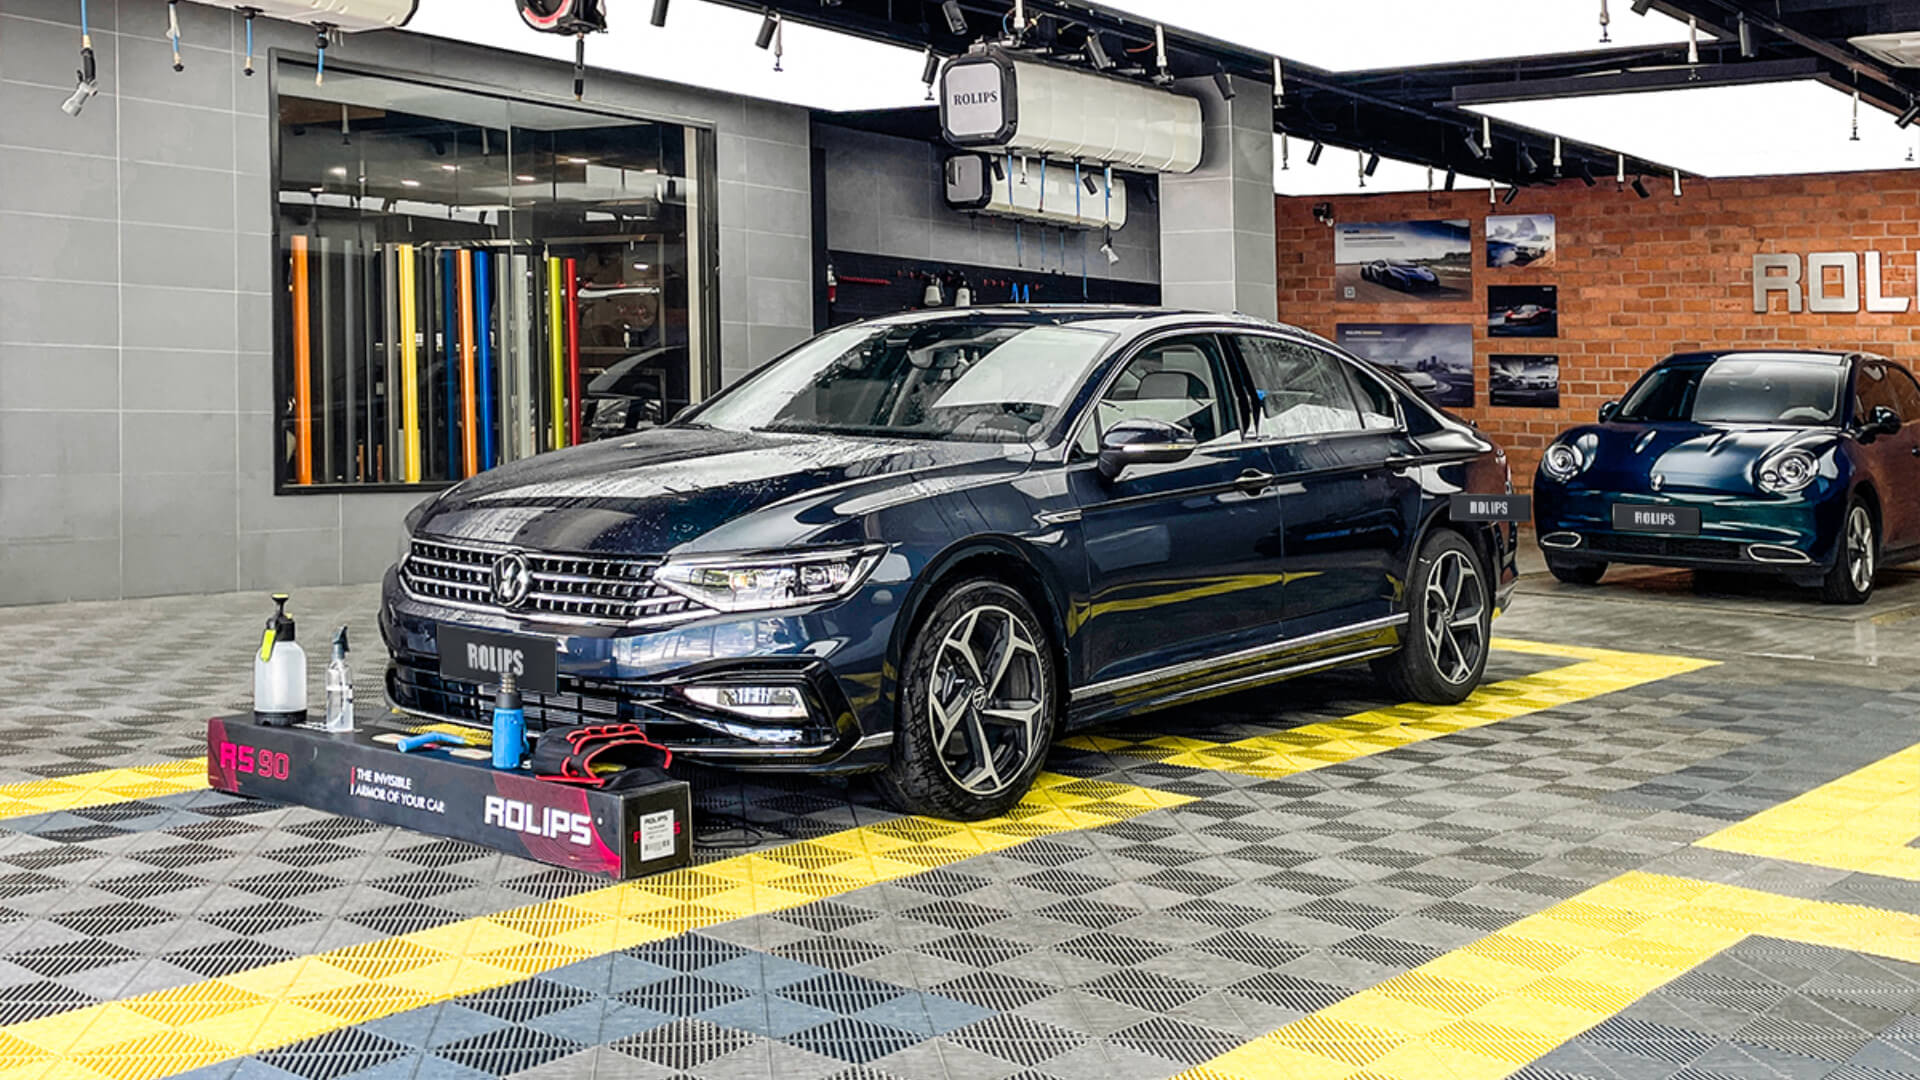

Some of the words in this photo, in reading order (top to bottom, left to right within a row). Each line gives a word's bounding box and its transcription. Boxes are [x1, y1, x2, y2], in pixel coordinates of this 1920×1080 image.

[953, 89, 998, 106] ROLIPS
[1752, 250, 1920, 313] ROL
[1634, 511, 1676, 526] ROLIPS
[466, 642, 524, 676] ROLIPS
[220, 741, 255, 773] RS
[258, 749, 290, 780] 90
[356, 767, 373, 782] THE
[374, 771, 412, 790] INVISIBLE
[355, 783, 386, 801] ARMOR
[387, 789, 400, 804] OF
[401, 793, 426, 809] YOUR
[426, 798, 445, 813] CAR
[484, 795, 592, 846] ROLIPS
